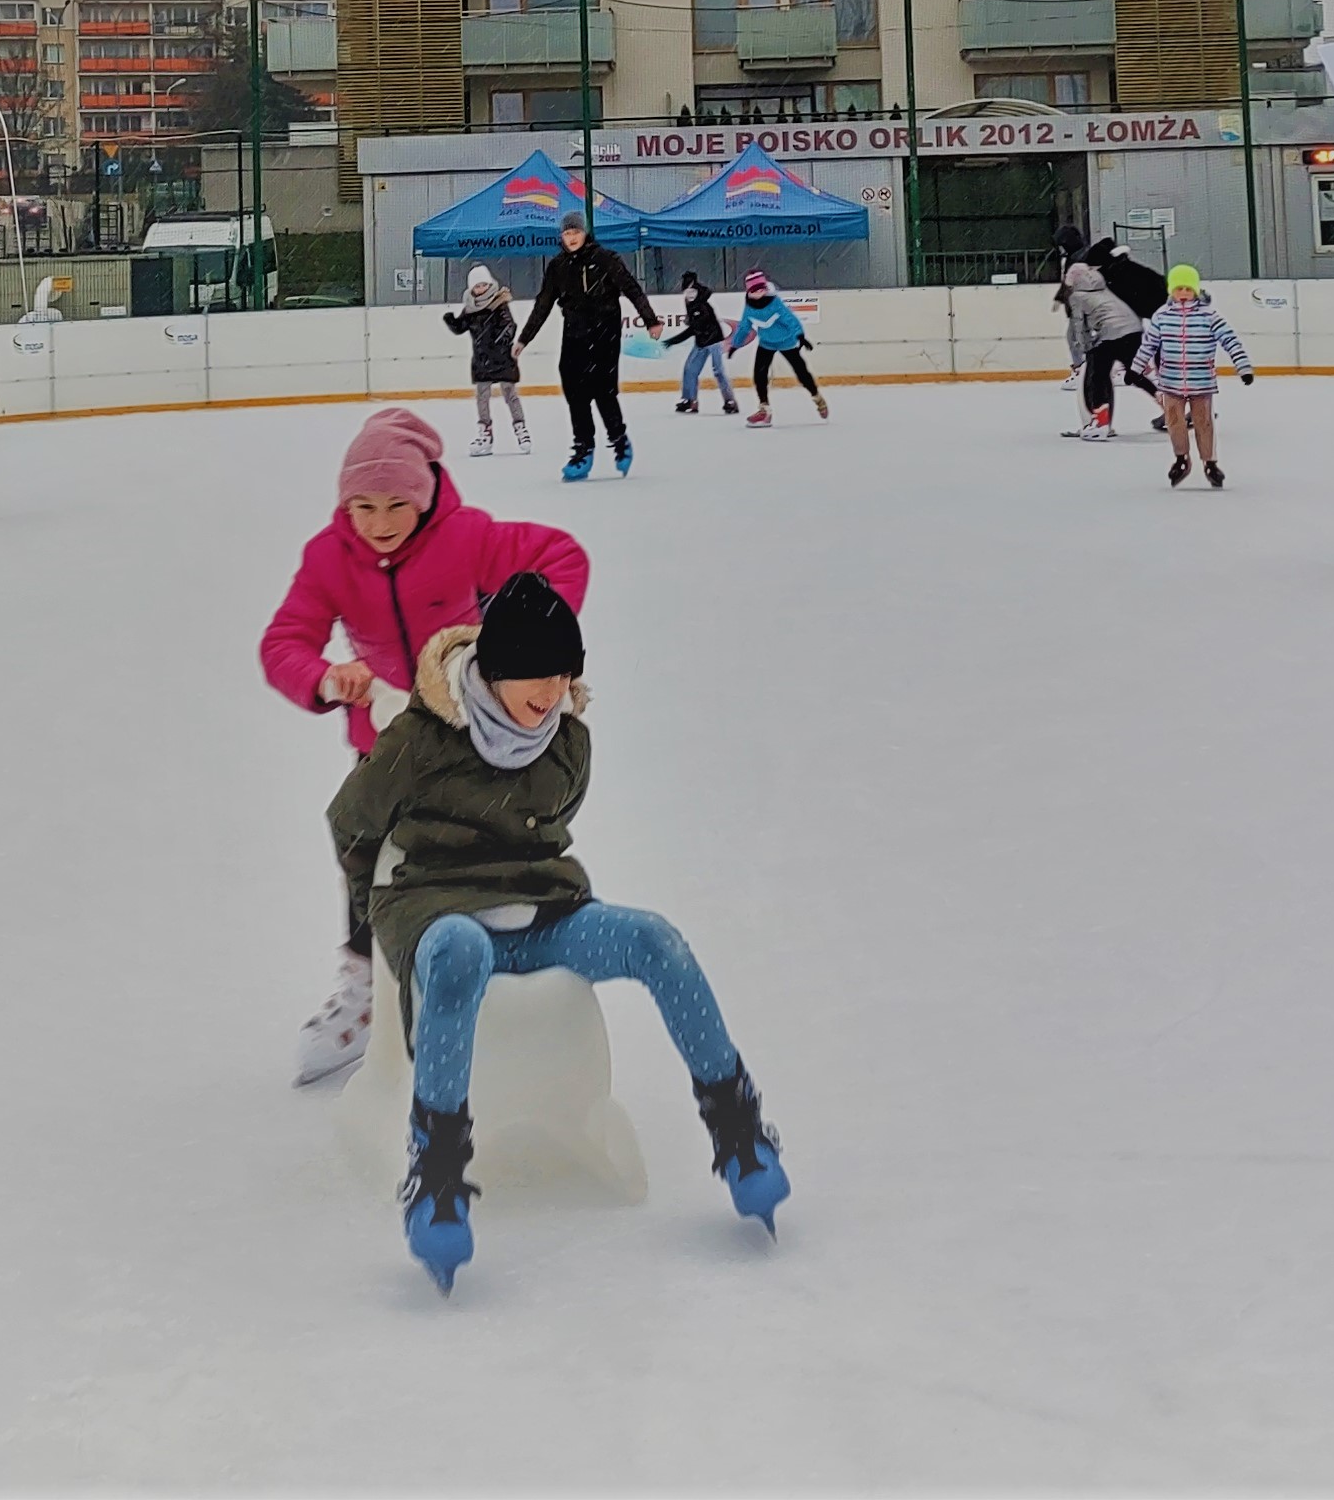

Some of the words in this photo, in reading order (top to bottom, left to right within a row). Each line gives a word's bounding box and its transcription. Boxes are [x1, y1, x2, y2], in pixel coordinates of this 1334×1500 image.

[636, 133, 724, 157] MOJE
[736, 128, 858, 154] BOISKO
[869, 124, 967, 149] ORLIK
[980, 122, 1055, 145] 2012
[1086, 115, 1201, 142] ŁOMŻA
